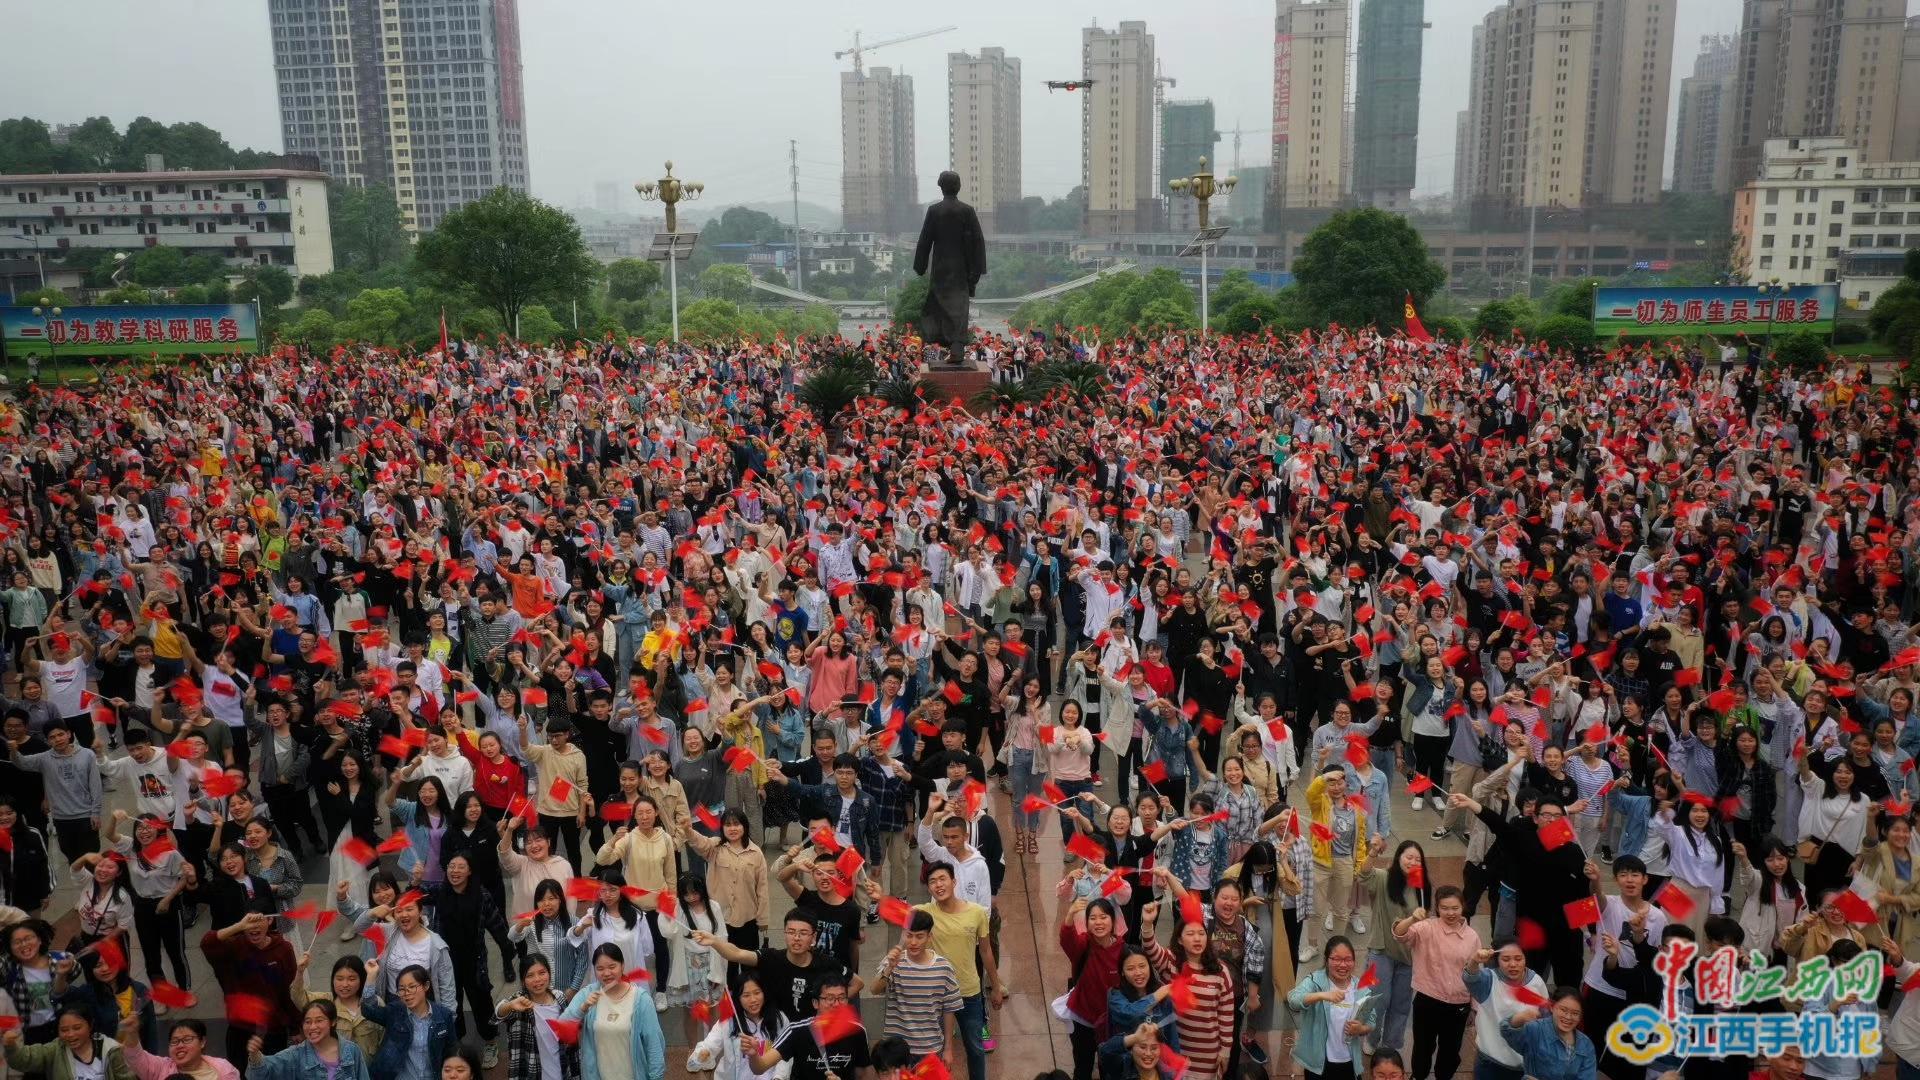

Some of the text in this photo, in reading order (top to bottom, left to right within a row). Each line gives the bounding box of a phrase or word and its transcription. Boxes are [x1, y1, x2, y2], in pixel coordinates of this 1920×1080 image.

[1612, 298, 1820, 324] 一切为师生员工服务
[20, 317, 240, 344] 一切为教学科研服务
